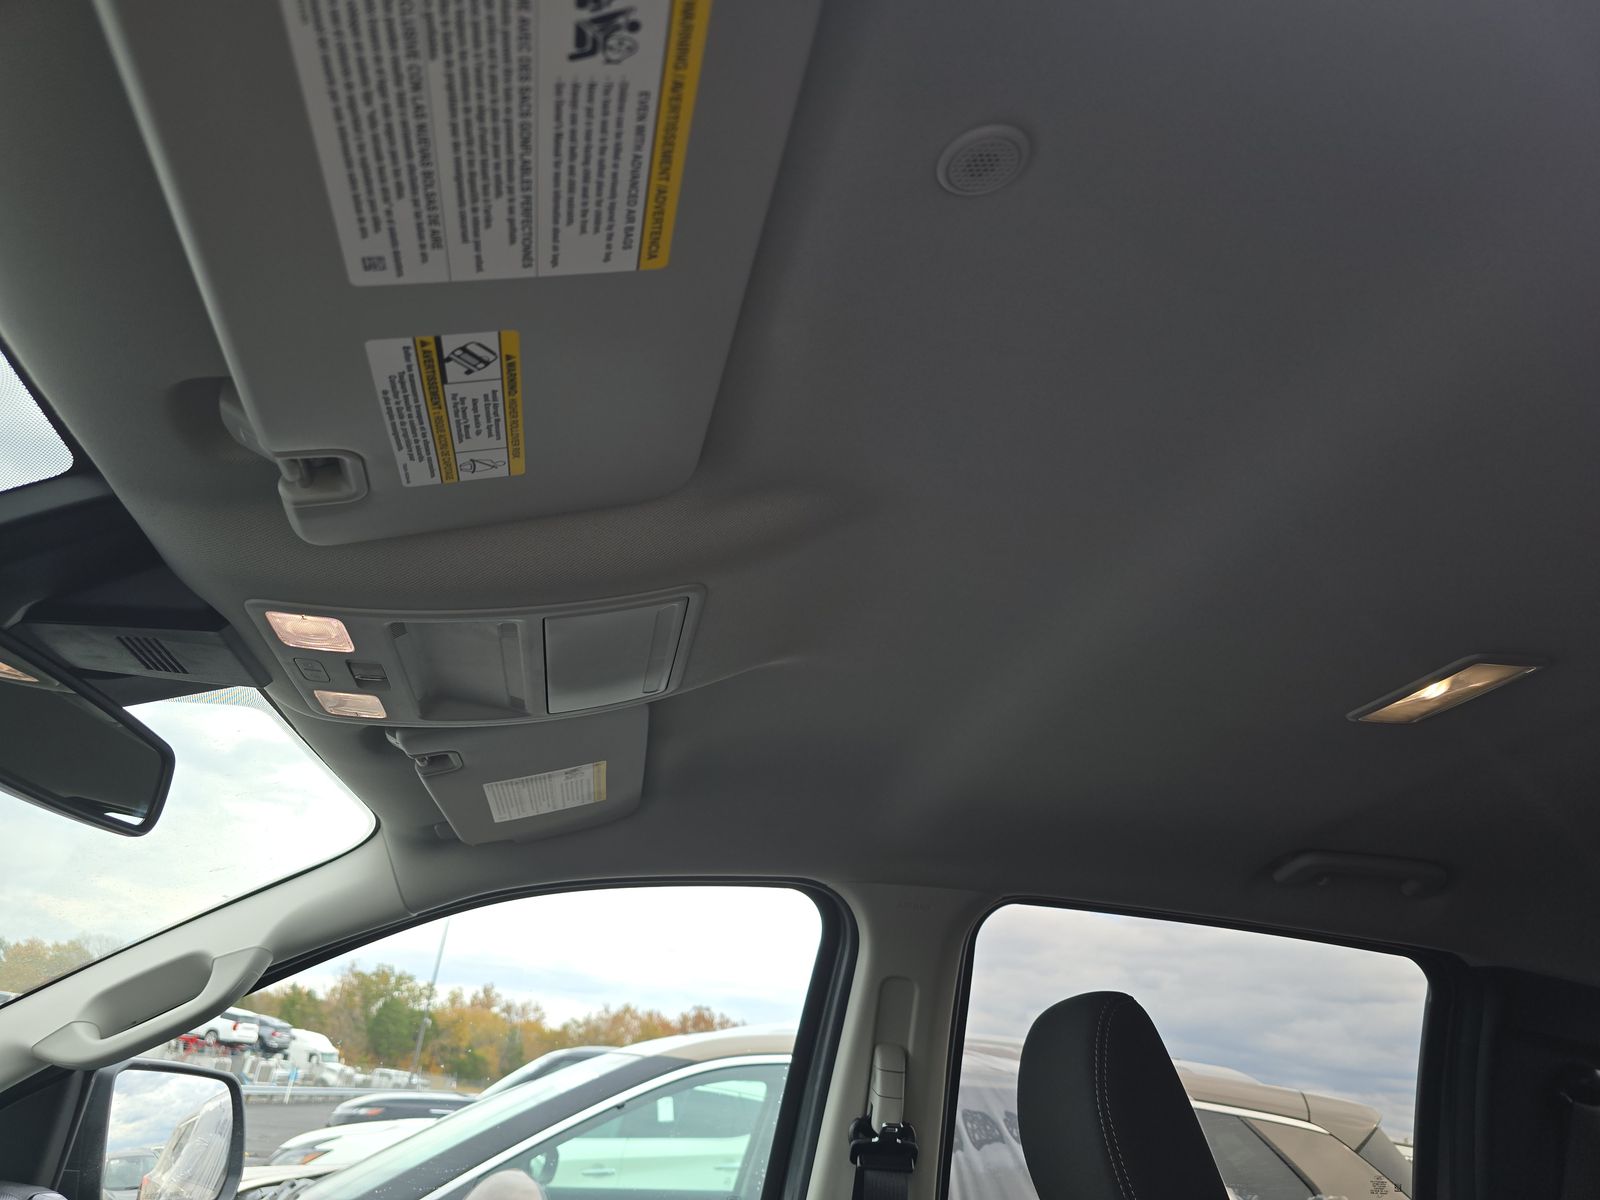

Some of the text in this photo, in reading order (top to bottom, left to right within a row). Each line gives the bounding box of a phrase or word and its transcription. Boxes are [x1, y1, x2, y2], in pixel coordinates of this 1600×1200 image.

[674, 1, 695, 69] WARNING
[406, 66, 422, 92] CON
[410, 97, 426, 118] LAS
[414, 123, 432, 166] NUEVAS
[622, 91, 649, 249] EVEN WITH ADVANCED AIR BAGS
[421, 170, 438, 210] BOLSAS
[427, 214, 439, 225] DE
[429, 229, 442, 248] AIRE
